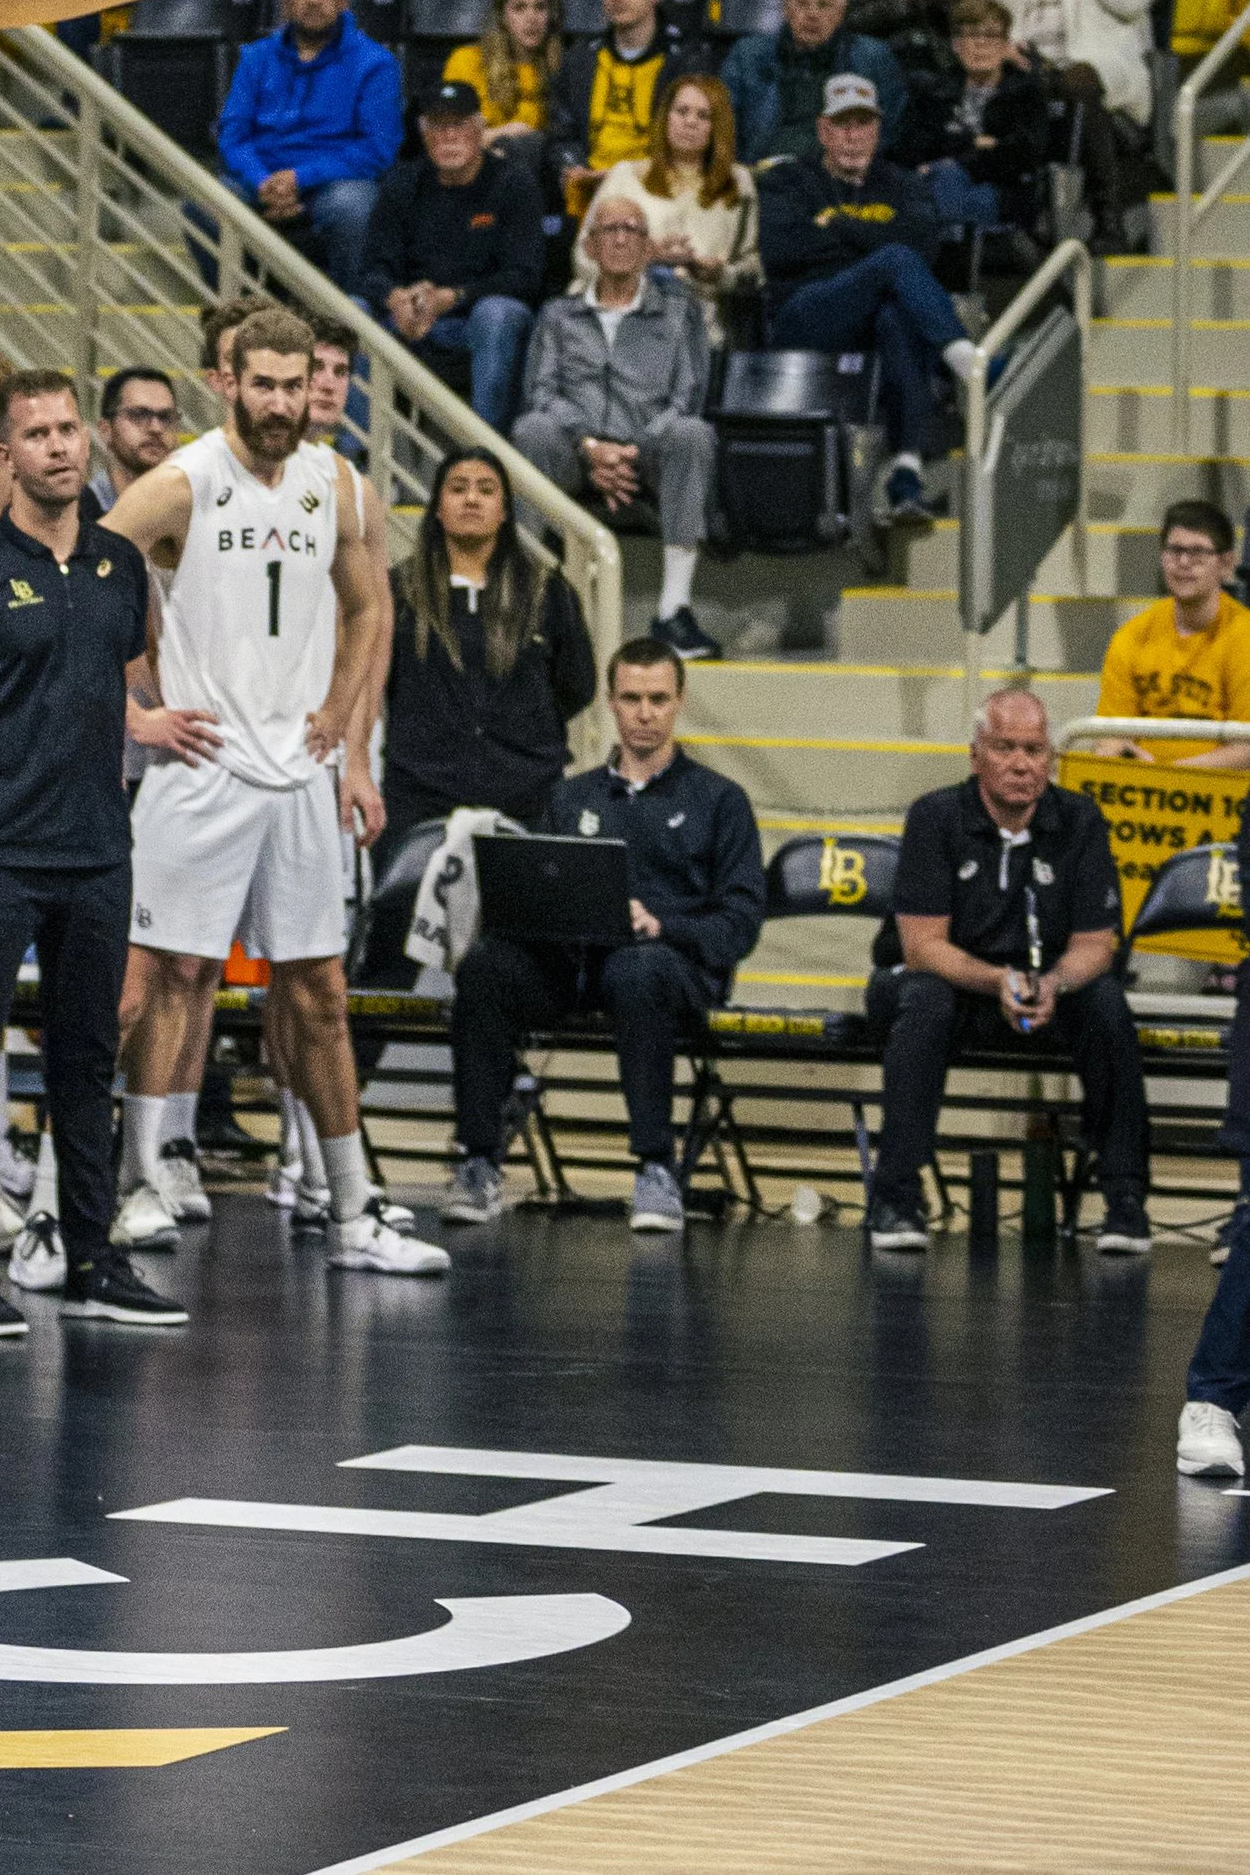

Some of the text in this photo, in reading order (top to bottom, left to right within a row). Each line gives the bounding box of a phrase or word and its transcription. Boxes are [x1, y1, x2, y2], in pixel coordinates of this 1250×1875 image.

[217, 527, 317, 558] BEACH
[266, 560, 283, 637] 1
[1079, 778, 1213, 816] SECTION
[1108, 819, 1187, 849] OWS
[817, 837, 868, 904] LB
